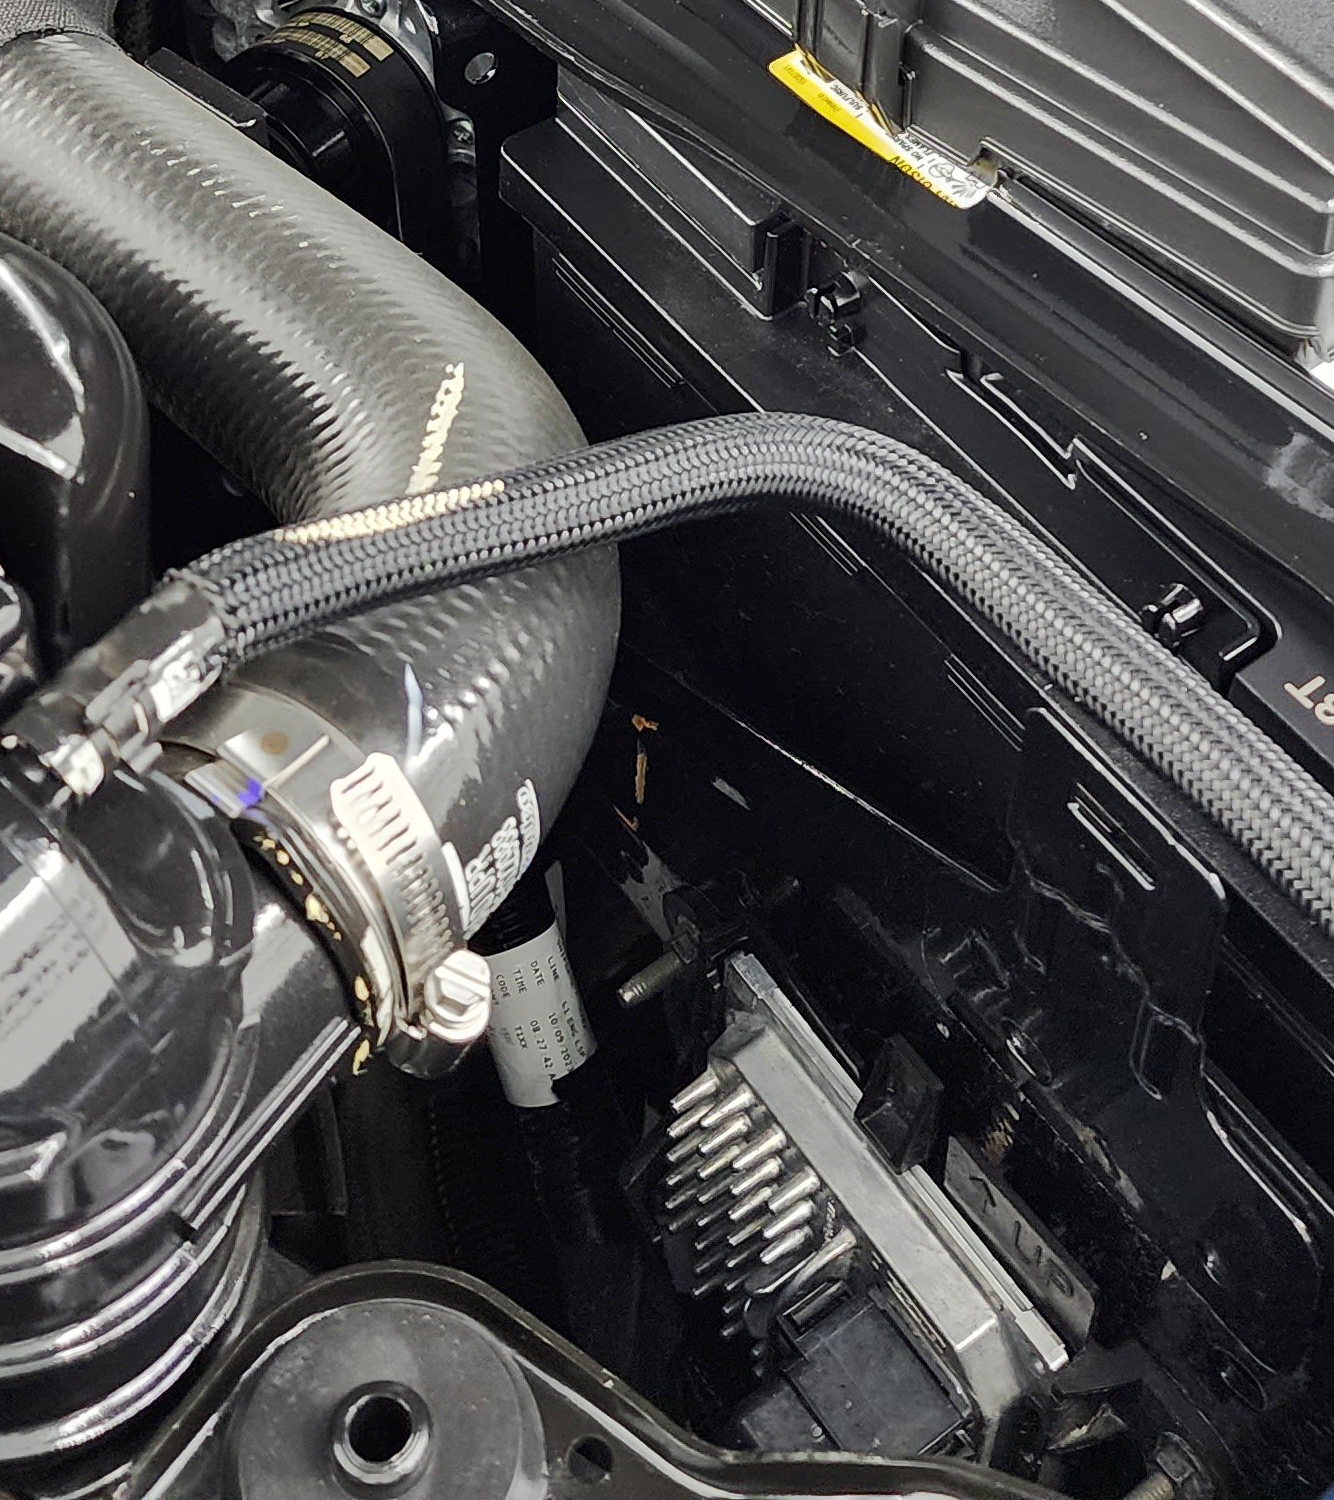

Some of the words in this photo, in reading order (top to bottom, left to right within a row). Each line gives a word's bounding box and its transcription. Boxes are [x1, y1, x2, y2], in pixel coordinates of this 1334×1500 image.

[512, 968, 527, 994] TIME
[529, 960, 545, 986] DATE
[546, 954, 560, 982] LINE
[495, 973, 510, 998] CODE
